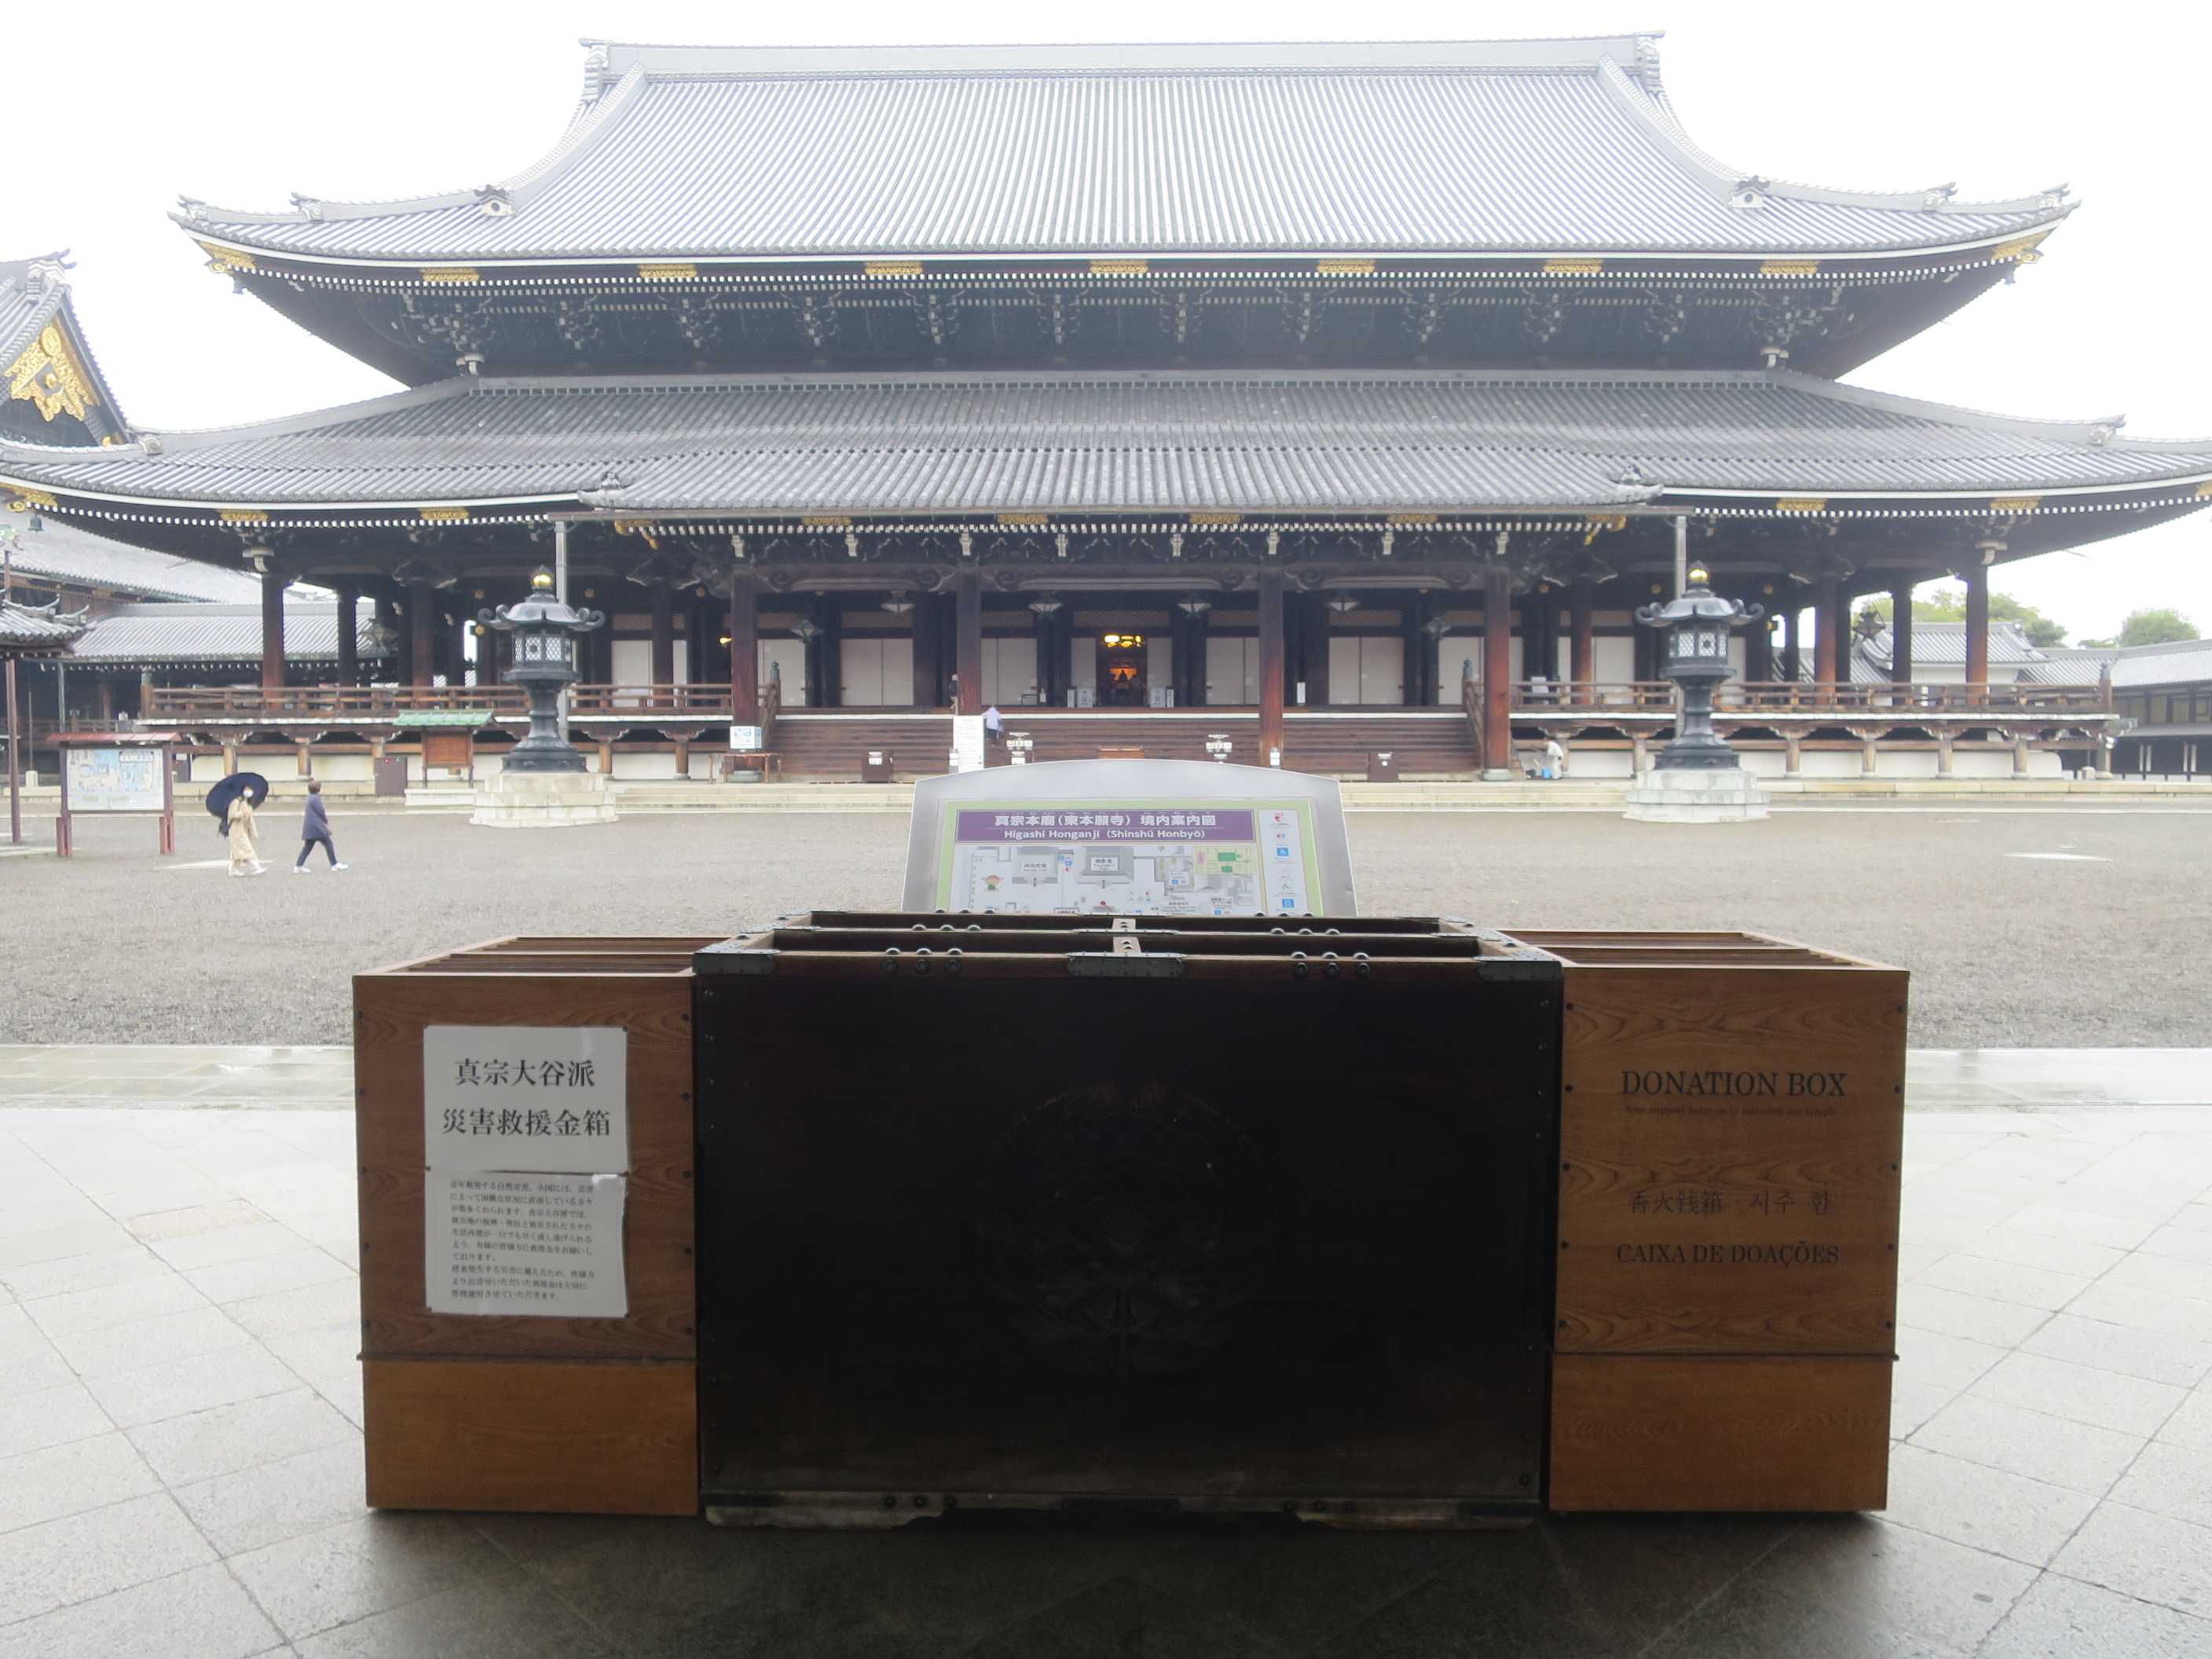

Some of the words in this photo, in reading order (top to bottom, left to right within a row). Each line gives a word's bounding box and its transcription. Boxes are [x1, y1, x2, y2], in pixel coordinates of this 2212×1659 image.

[1140, 815, 1217, 826] 境内案内図
[1004, 830, 1046, 840] Higashi
[1048, 830, 1100, 840] Honganji
[1106, 829, 1154, 840] (Shinshū
[1157, 829, 1206, 840] Honbyō)
[454, 1058, 596, 1088] 真宗大谷派
[1621, 1070, 1778, 1096] DONATION
[1786, 1072, 1848, 1097] BOX
[441, 1108, 610, 1137] 災害救援金箱
[1617, 1243, 1686, 1263] CAIXA
[1691, 1244, 1723, 1263] DE
[1730, 1241, 1840, 1267] DOAÇÕES
